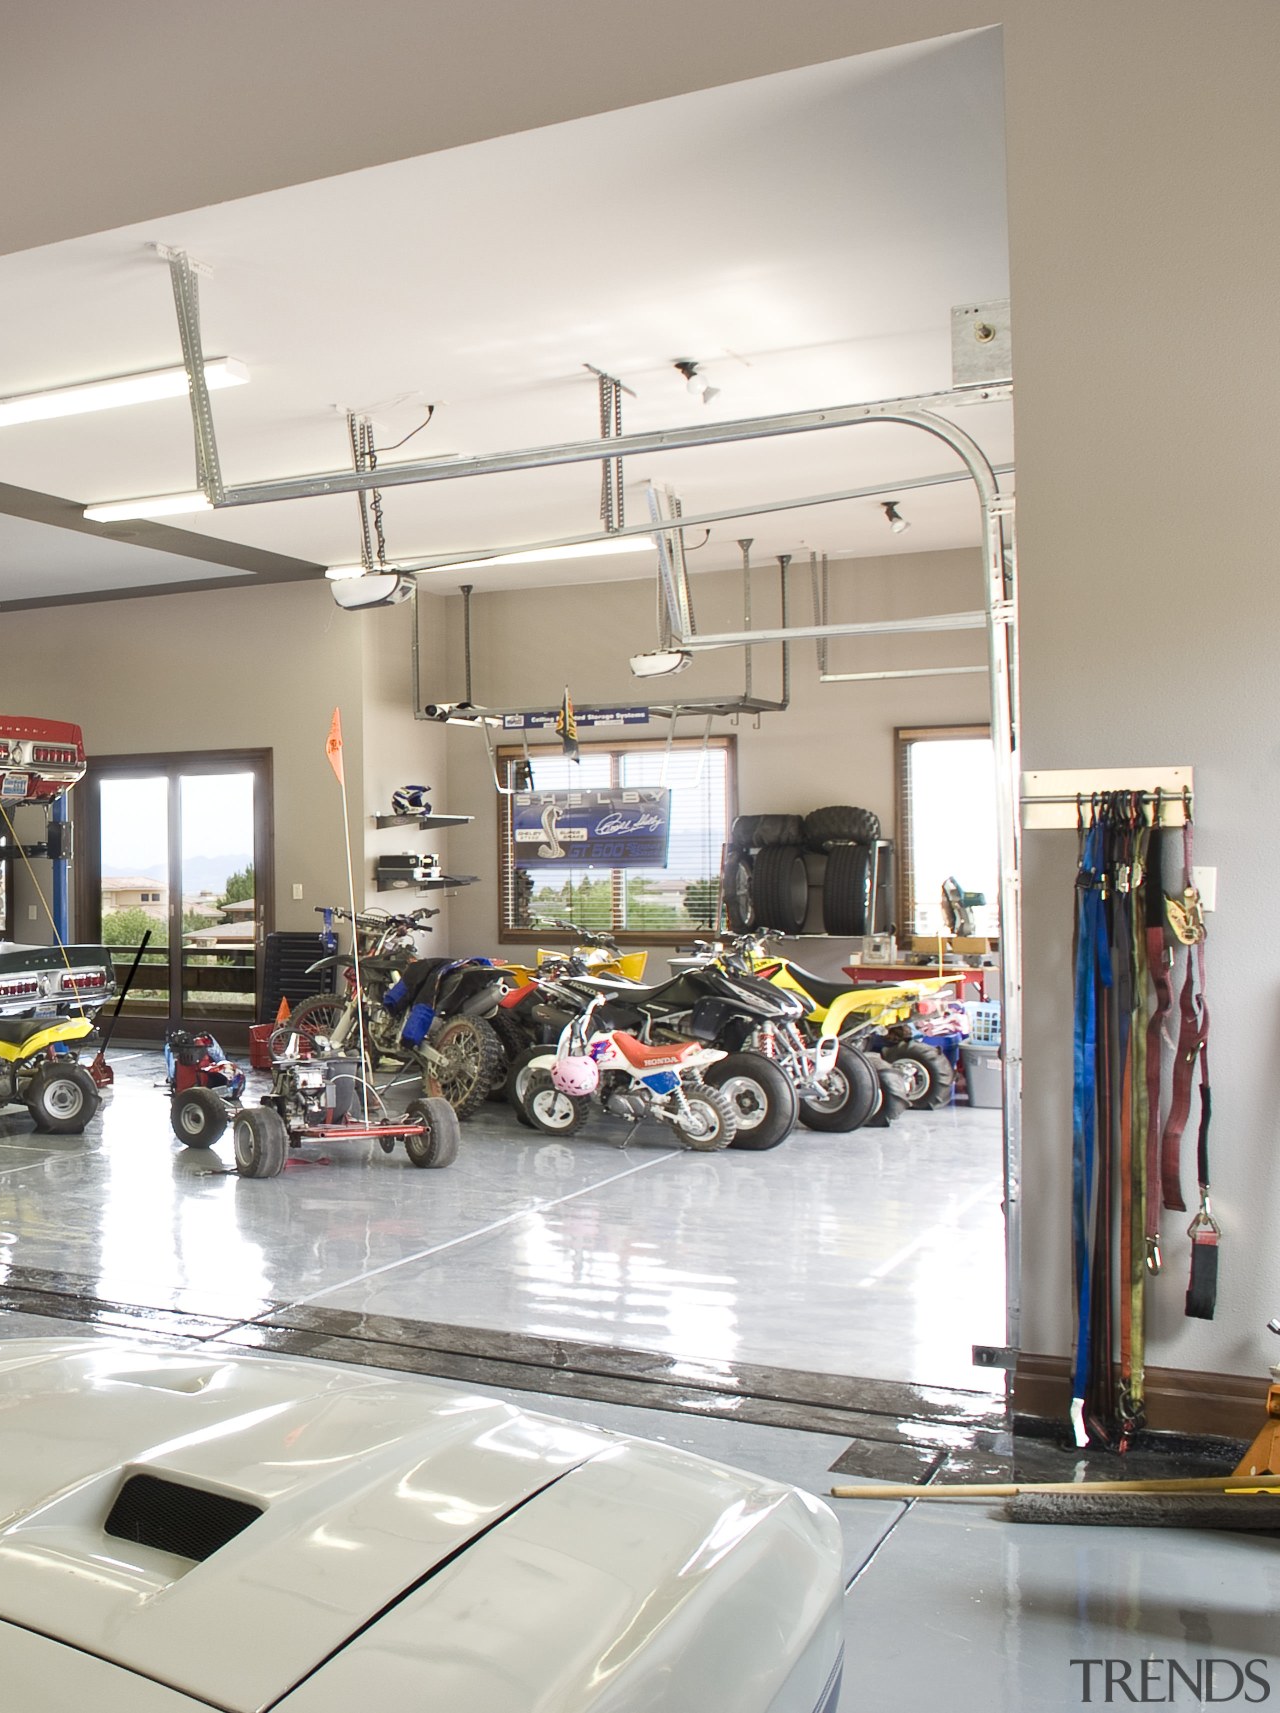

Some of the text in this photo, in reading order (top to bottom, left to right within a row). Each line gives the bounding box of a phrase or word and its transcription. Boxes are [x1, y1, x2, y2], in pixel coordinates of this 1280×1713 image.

[531, 716, 555, 724] Ceiling
[587, 713, 614, 721] Storage
[616, 711, 646, 720] Systems
[516, 791, 665, 805] SHELBY
[570, 843, 590, 858] GT
[592, 843, 624, 858] 500
[569, 981, 600, 996] HOND
[644, 1057, 679, 1066] HONDA
